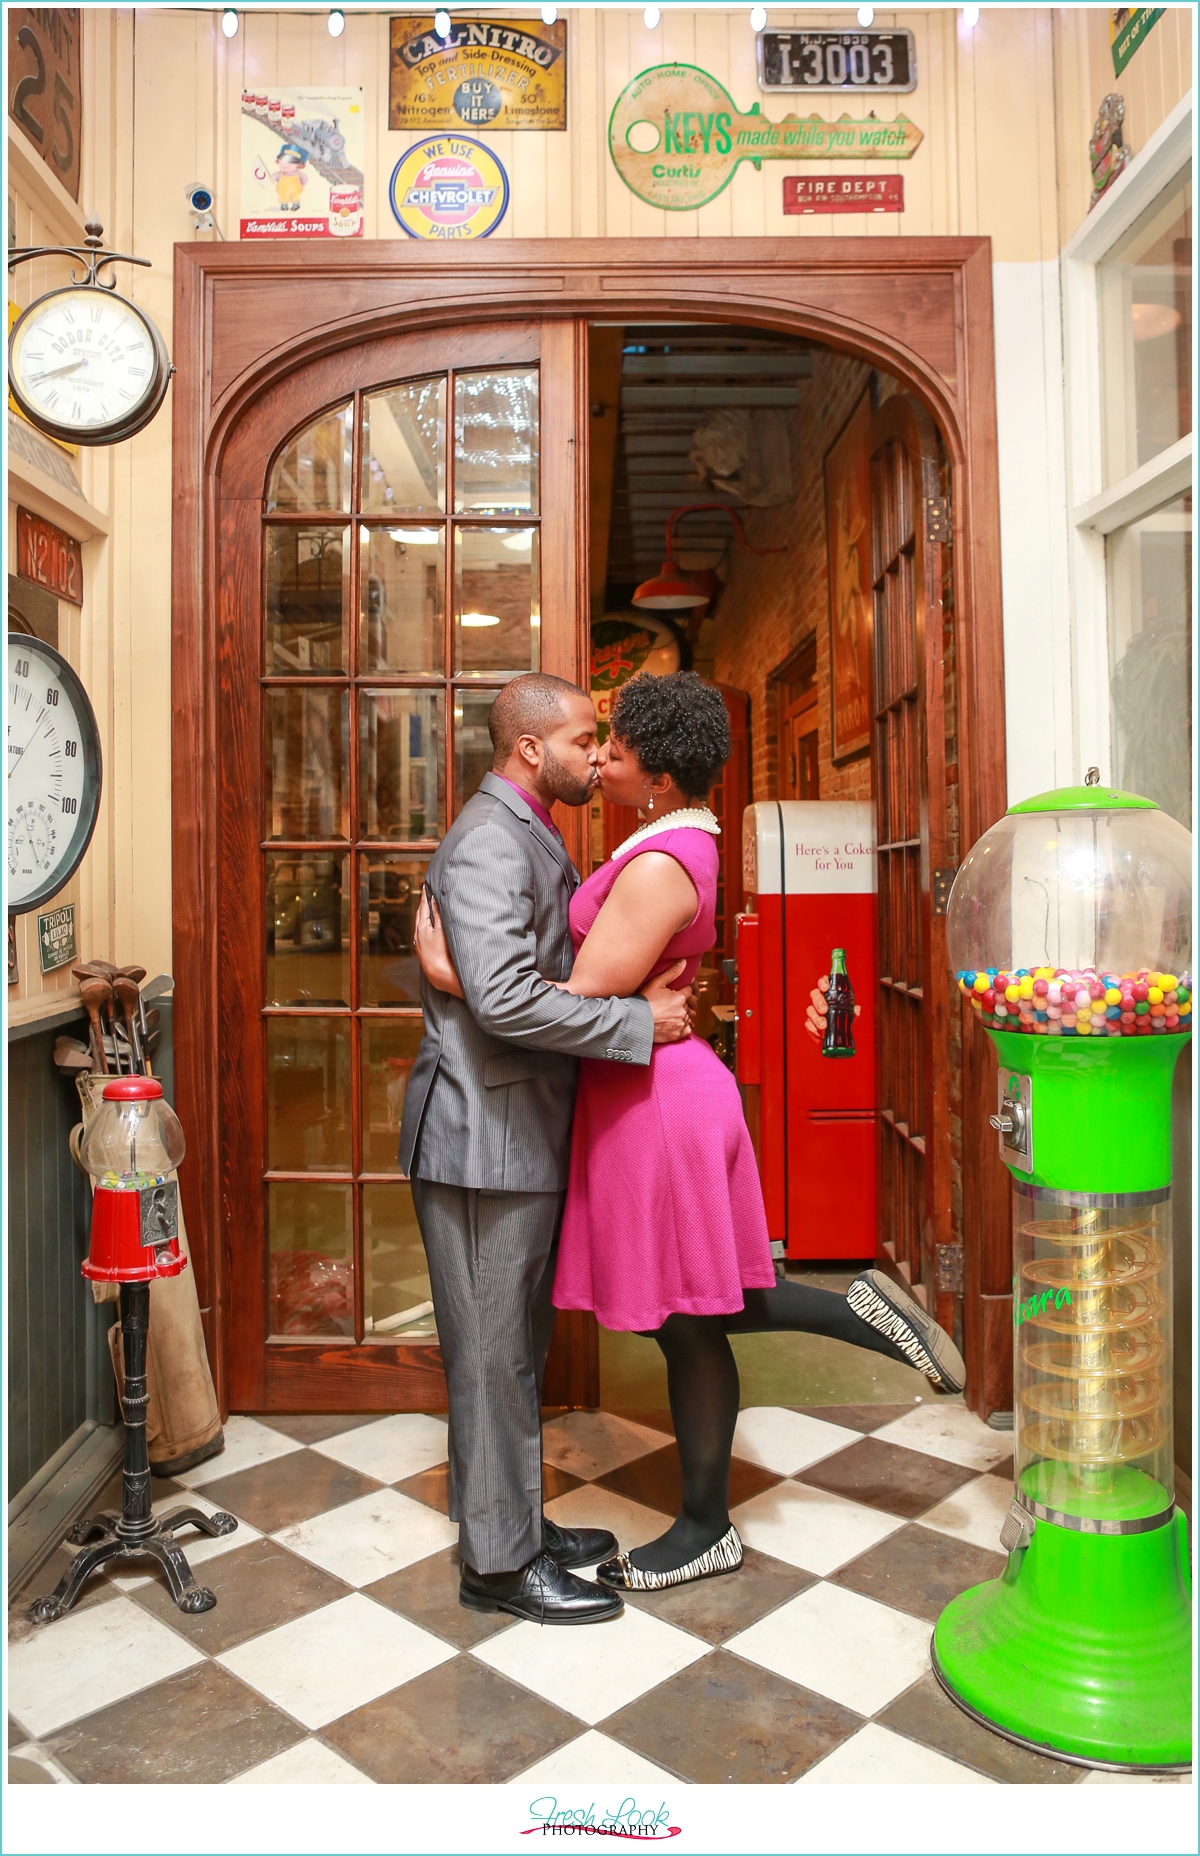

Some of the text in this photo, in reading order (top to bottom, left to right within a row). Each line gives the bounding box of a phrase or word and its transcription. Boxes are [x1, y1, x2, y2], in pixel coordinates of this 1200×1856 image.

[1118, 8, 1156, 59] HIT OF TH
[402, 23, 553, 66] CAL-NITRO
[415, 61, 437, 77] Top
[438, 53, 458, 67] and
[424, 63, 531, 93] FERTILIZER
[631, 70, 721, 101] AUTO HOME OFFICE
[461, 82, 493, 94] BUY
[13, 26, 74, 173] 25
[471, 94, 483, 107] IT
[397, 104, 450, 117] Nitrogen
[461, 108, 495, 121] HERE
[504, 105, 560, 116] Limestone
[664, 111, 907, 155] KEYS made while you watch
[422, 143, 475, 160] WE USE
[423, 163, 475, 181] Genuine
[651, 164, 702, 179] Curtis
[409, 189, 491, 204] CHEVROLET
[796, 181, 837, 194] FIRE
[290, 219, 324, 232] SOUPS
[429, 223, 472, 239] PARTS
[51, 328, 126, 364] DODGE CITY
[73, 347, 103, 359] STATION
[73, 385, 90, 393] 1879
[14, 659, 29, 679] 40
[46, 688, 59, 707] 60
[65, 740, 77, 758] 80
[61, 796, 77, 815] 100
[795, 842, 872, 856] Here's a Coke
[814, 857, 854, 870] for You
[43, 908, 72, 931] TRIPOLI
